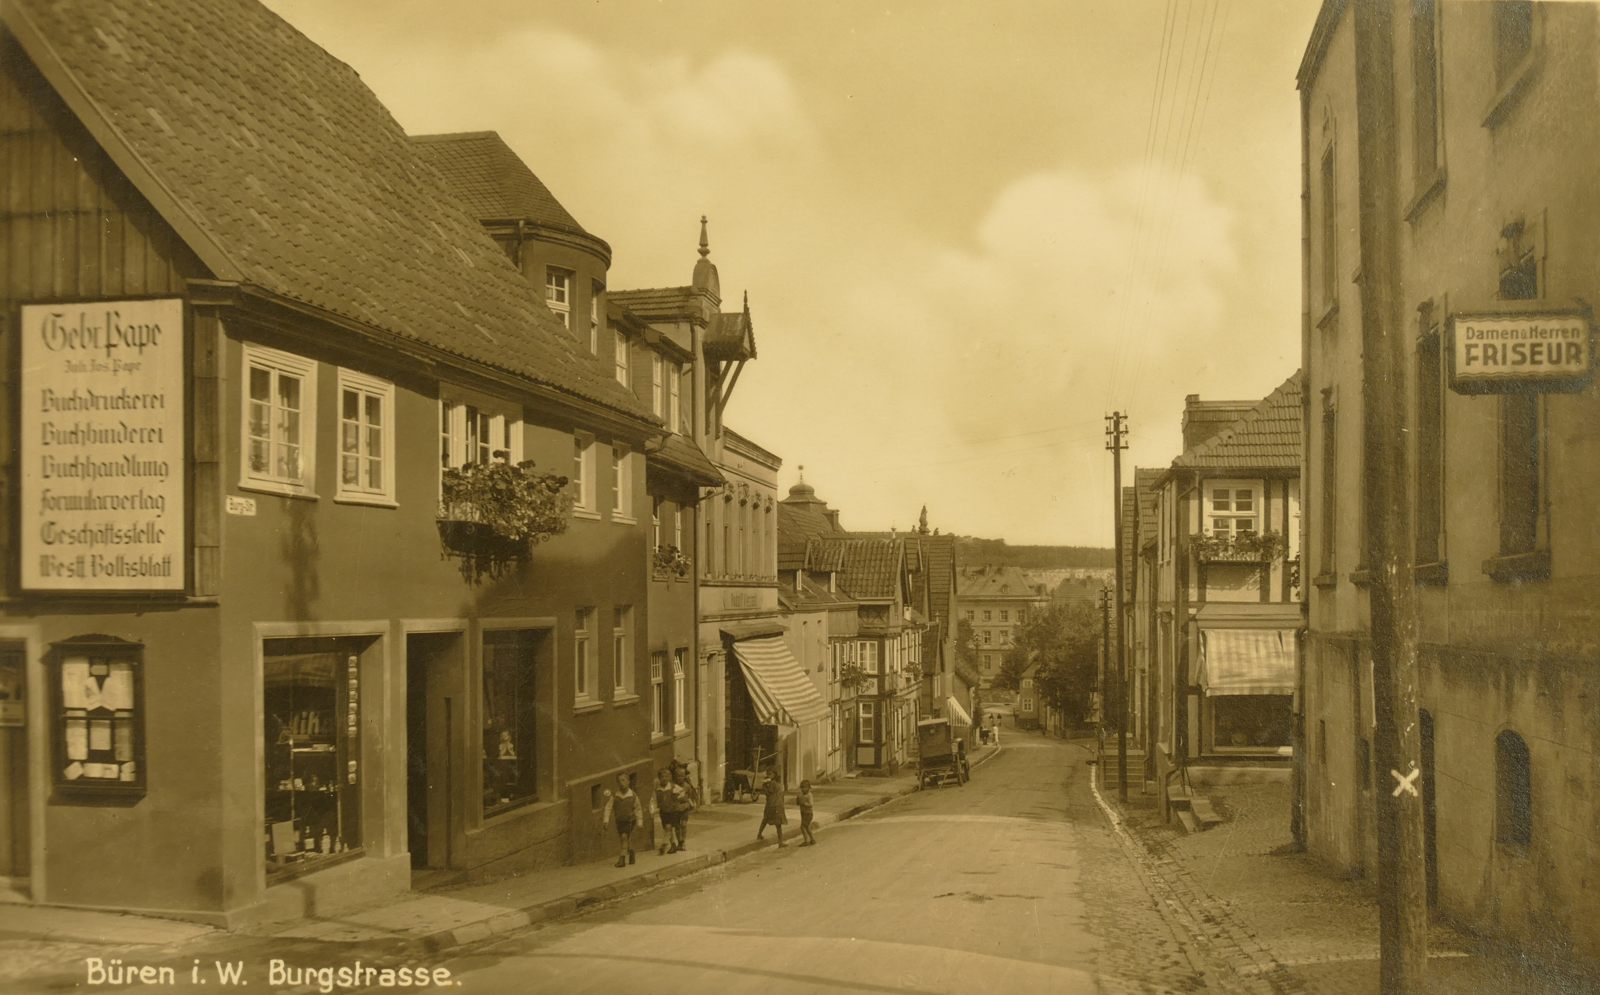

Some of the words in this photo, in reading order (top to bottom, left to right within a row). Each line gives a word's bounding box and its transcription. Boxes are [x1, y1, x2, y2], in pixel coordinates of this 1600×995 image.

[104, 311, 162, 357] Pape
[1466, 326, 1519, 340] Damen
[1529, 325, 1581, 339] Herren
[1465, 341, 1582, 366] FRISEUR
[41, 387, 165, 412] Buchdruckerei
[41, 421, 164, 446] Buchbinderei
[41, 454, 169, 482] Buchhandlung
[39, 488, 165, 518] Formularverlag
[40, 520, 165, 548] Geschäftsstelle
[90, 553, 172, 579] Volksblatt
